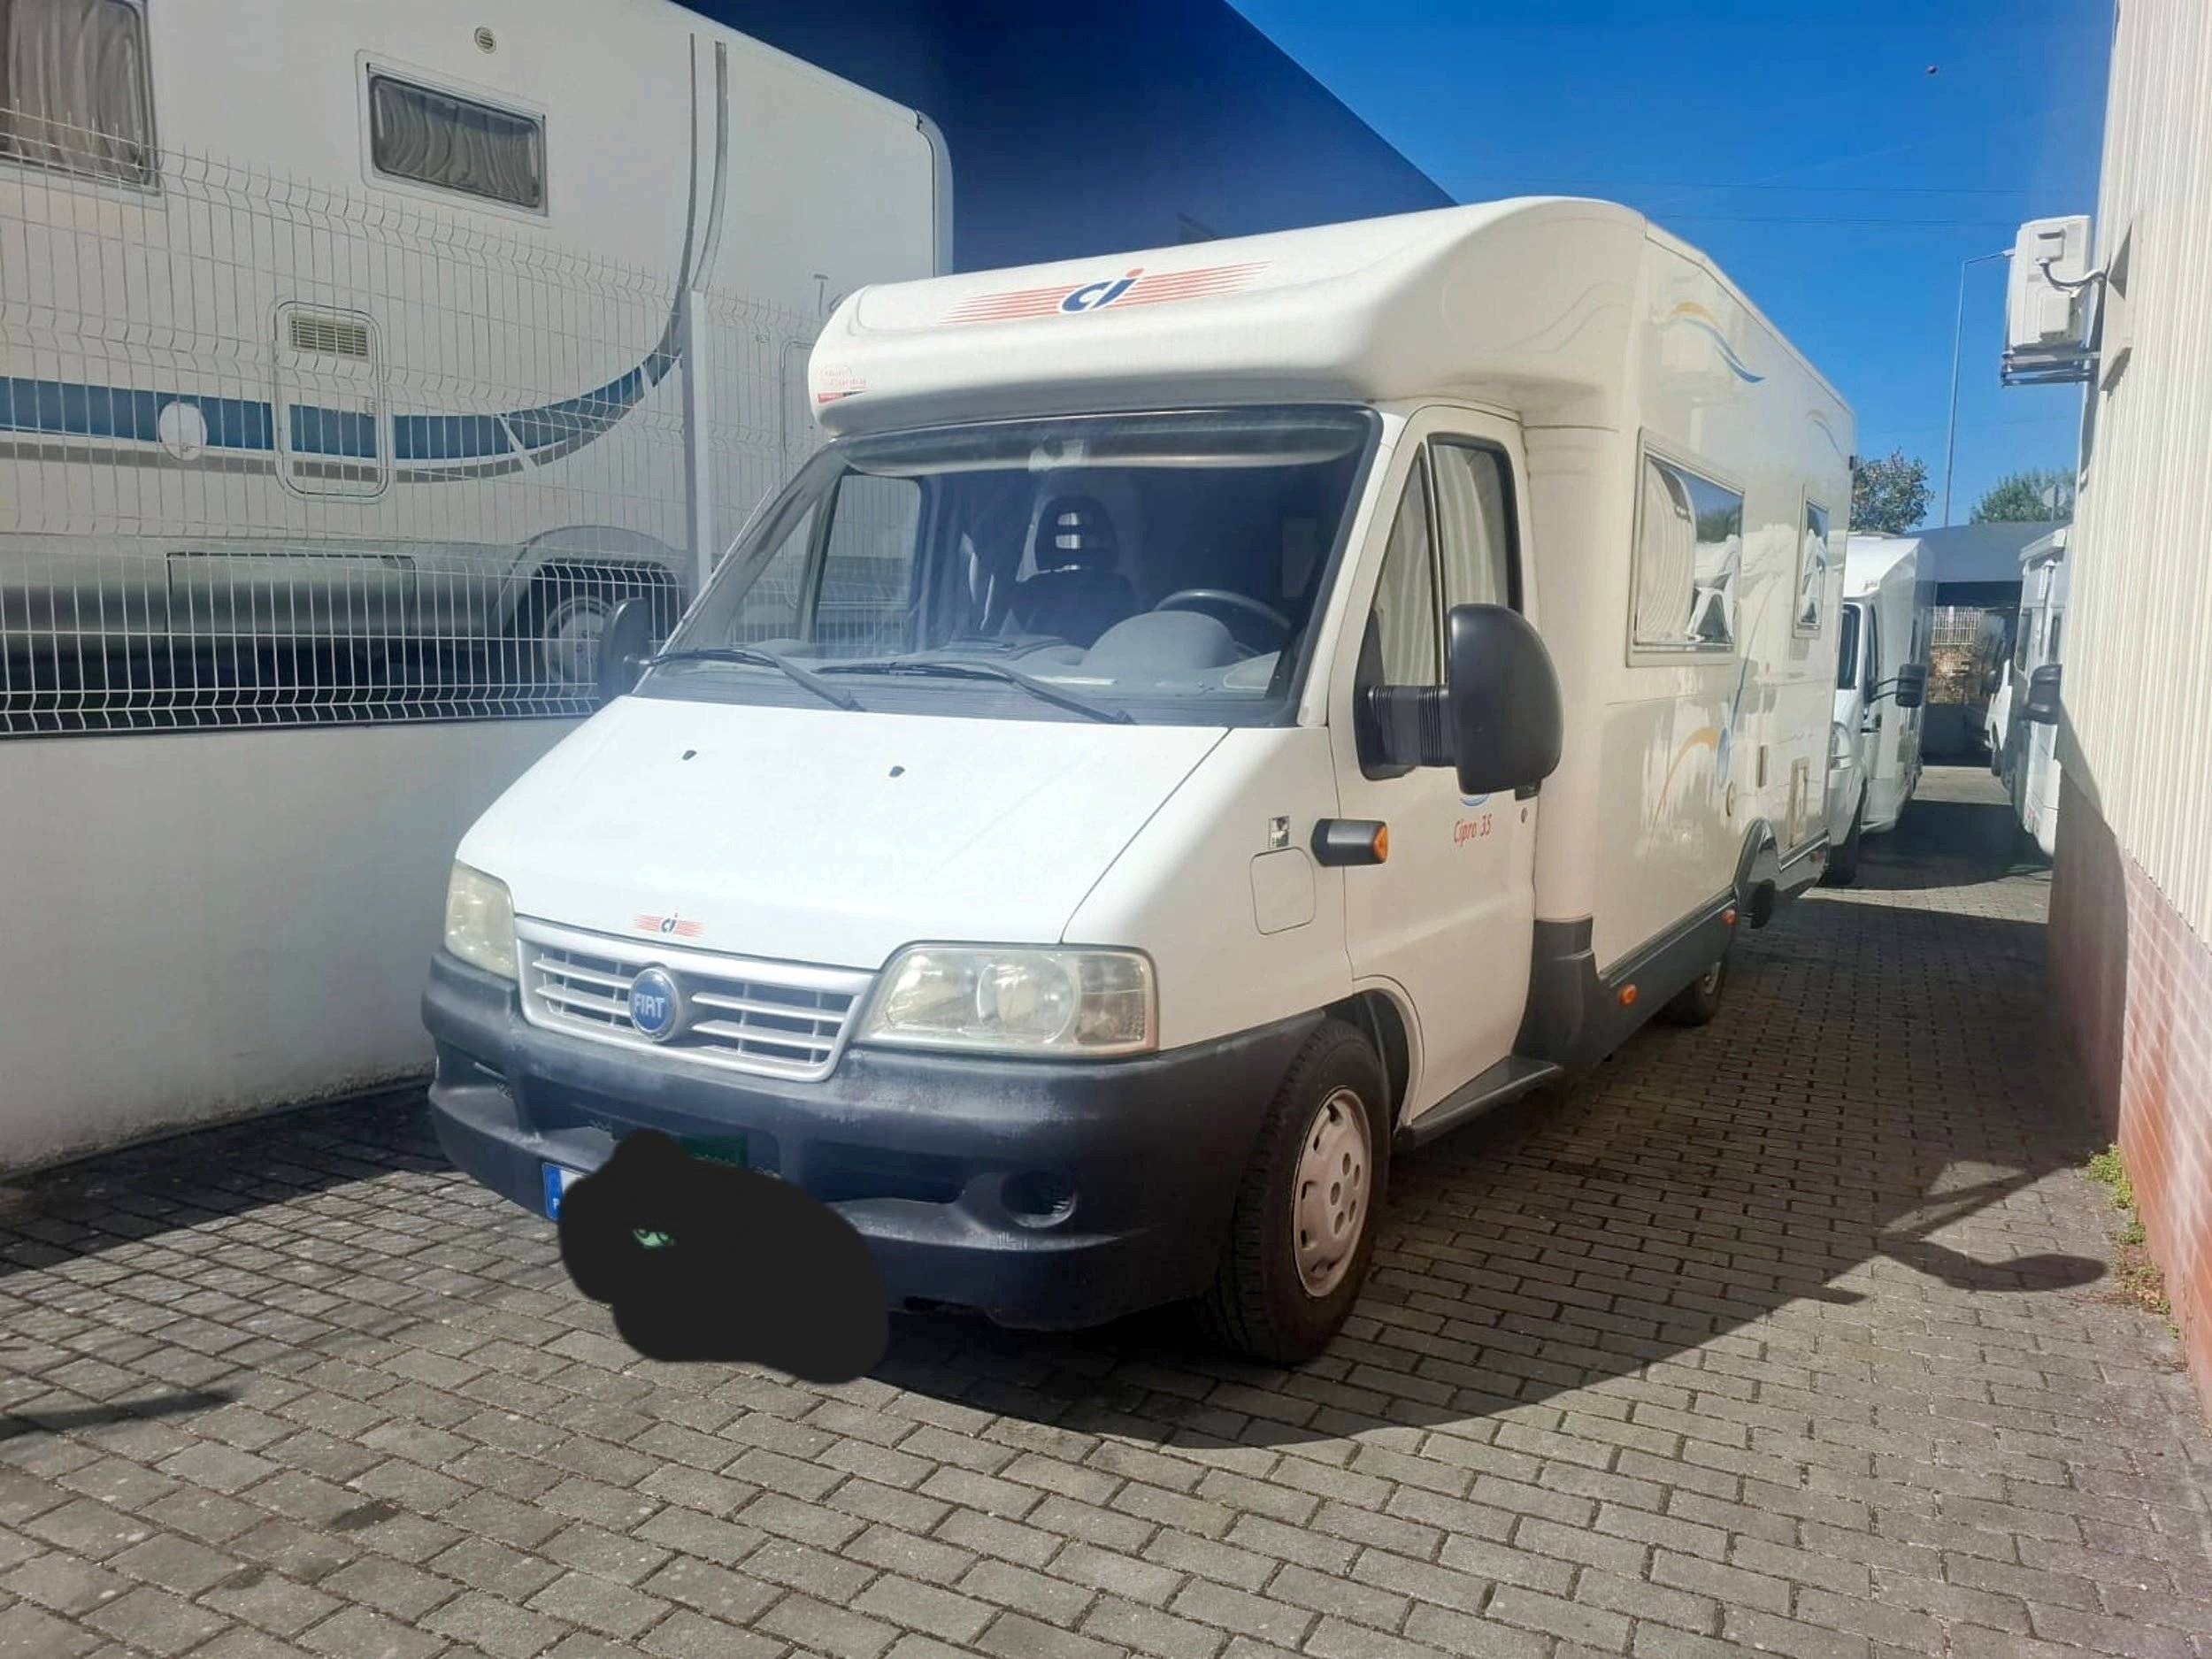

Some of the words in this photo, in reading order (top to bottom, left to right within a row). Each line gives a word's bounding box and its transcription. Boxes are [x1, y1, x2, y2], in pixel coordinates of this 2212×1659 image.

[1454, 818, 1478, 847] Cipro
[1480, 813, 1494, 837] 35
[634, 992, 665, 1018] FIAT
